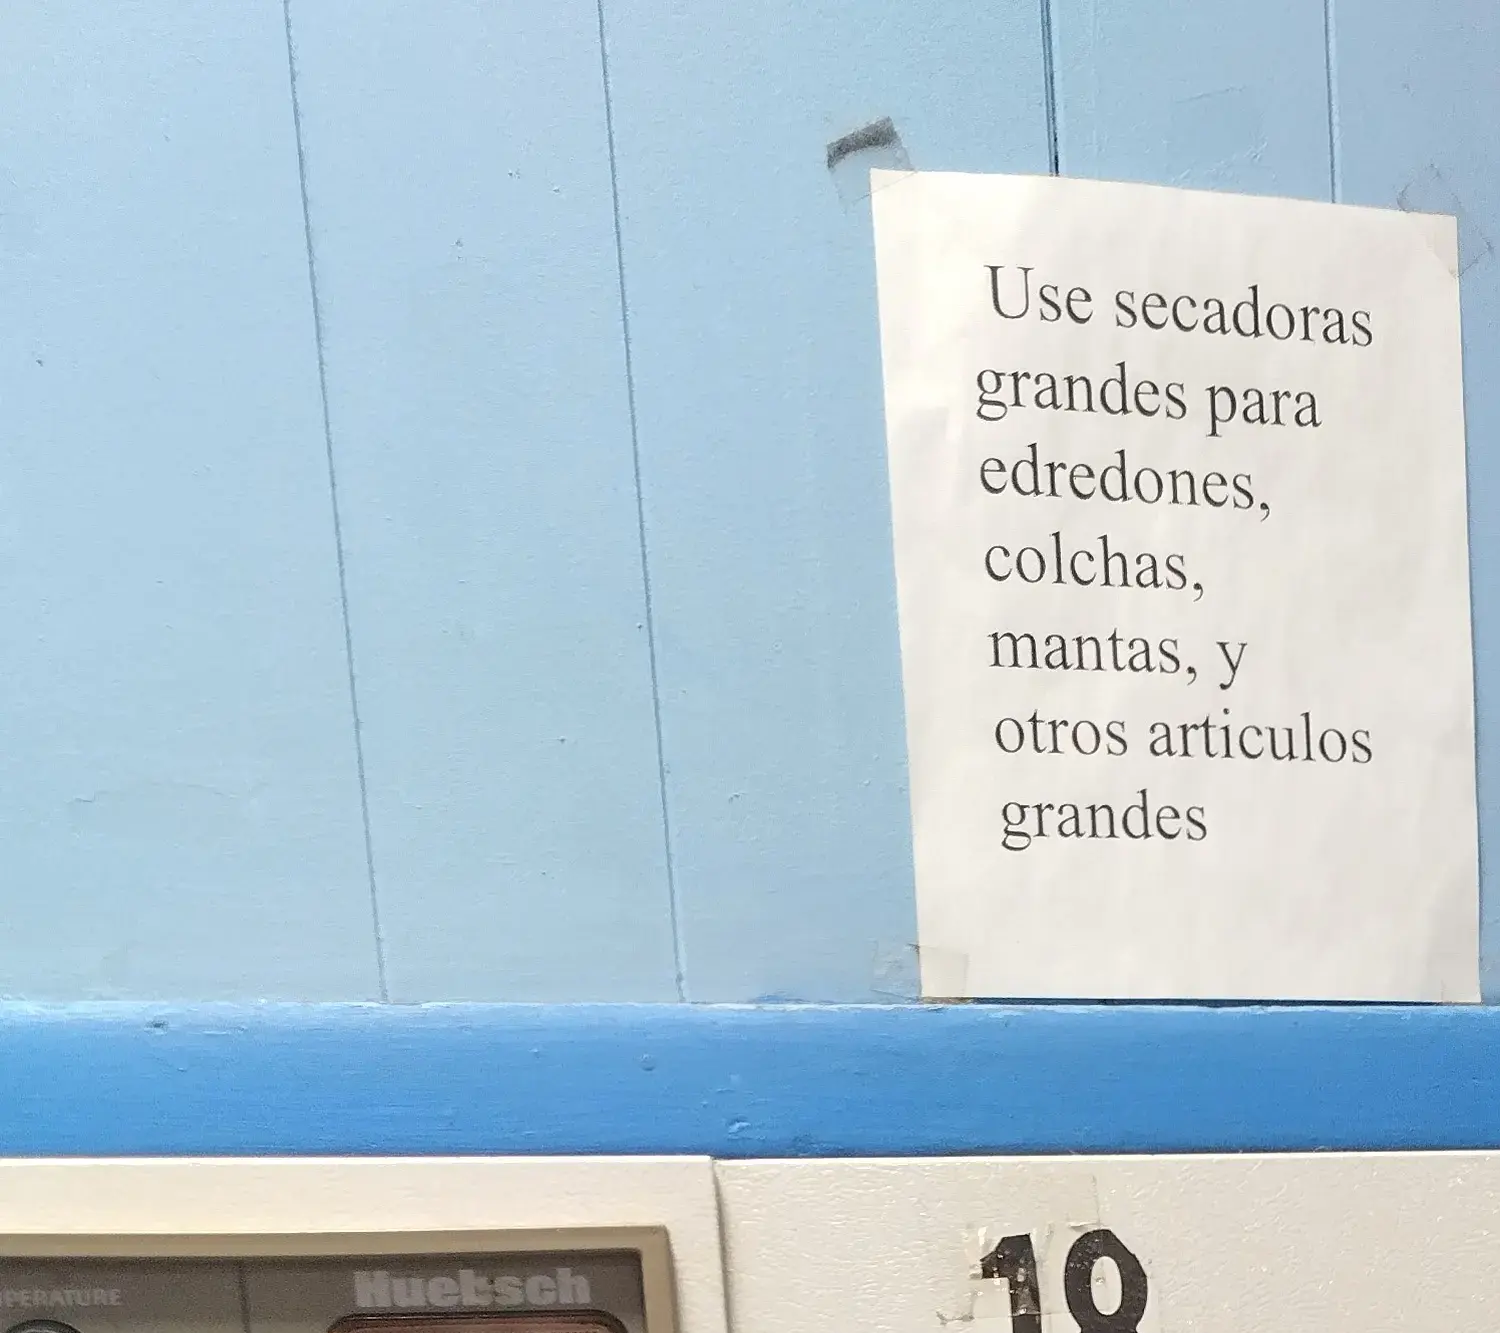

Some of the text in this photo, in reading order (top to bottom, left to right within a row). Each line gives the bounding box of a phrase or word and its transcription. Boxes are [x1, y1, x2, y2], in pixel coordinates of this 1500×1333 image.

[984, 265, 1373, 347] Use secadoras
[976, 361, 1322, 437] grandes para
[980, 442, 1270, 521] edredones,
[985, 531, 1204, 602] colchas,
[990, 630, 1247, 691] mantas, y
[995, 708, 1372, 764] otros articulos
[1001, 788, 1207, 852] grandes
[0, 1288, 122, 1307] PERATURE
[353, 1267, 591, 1308] Huebsch
